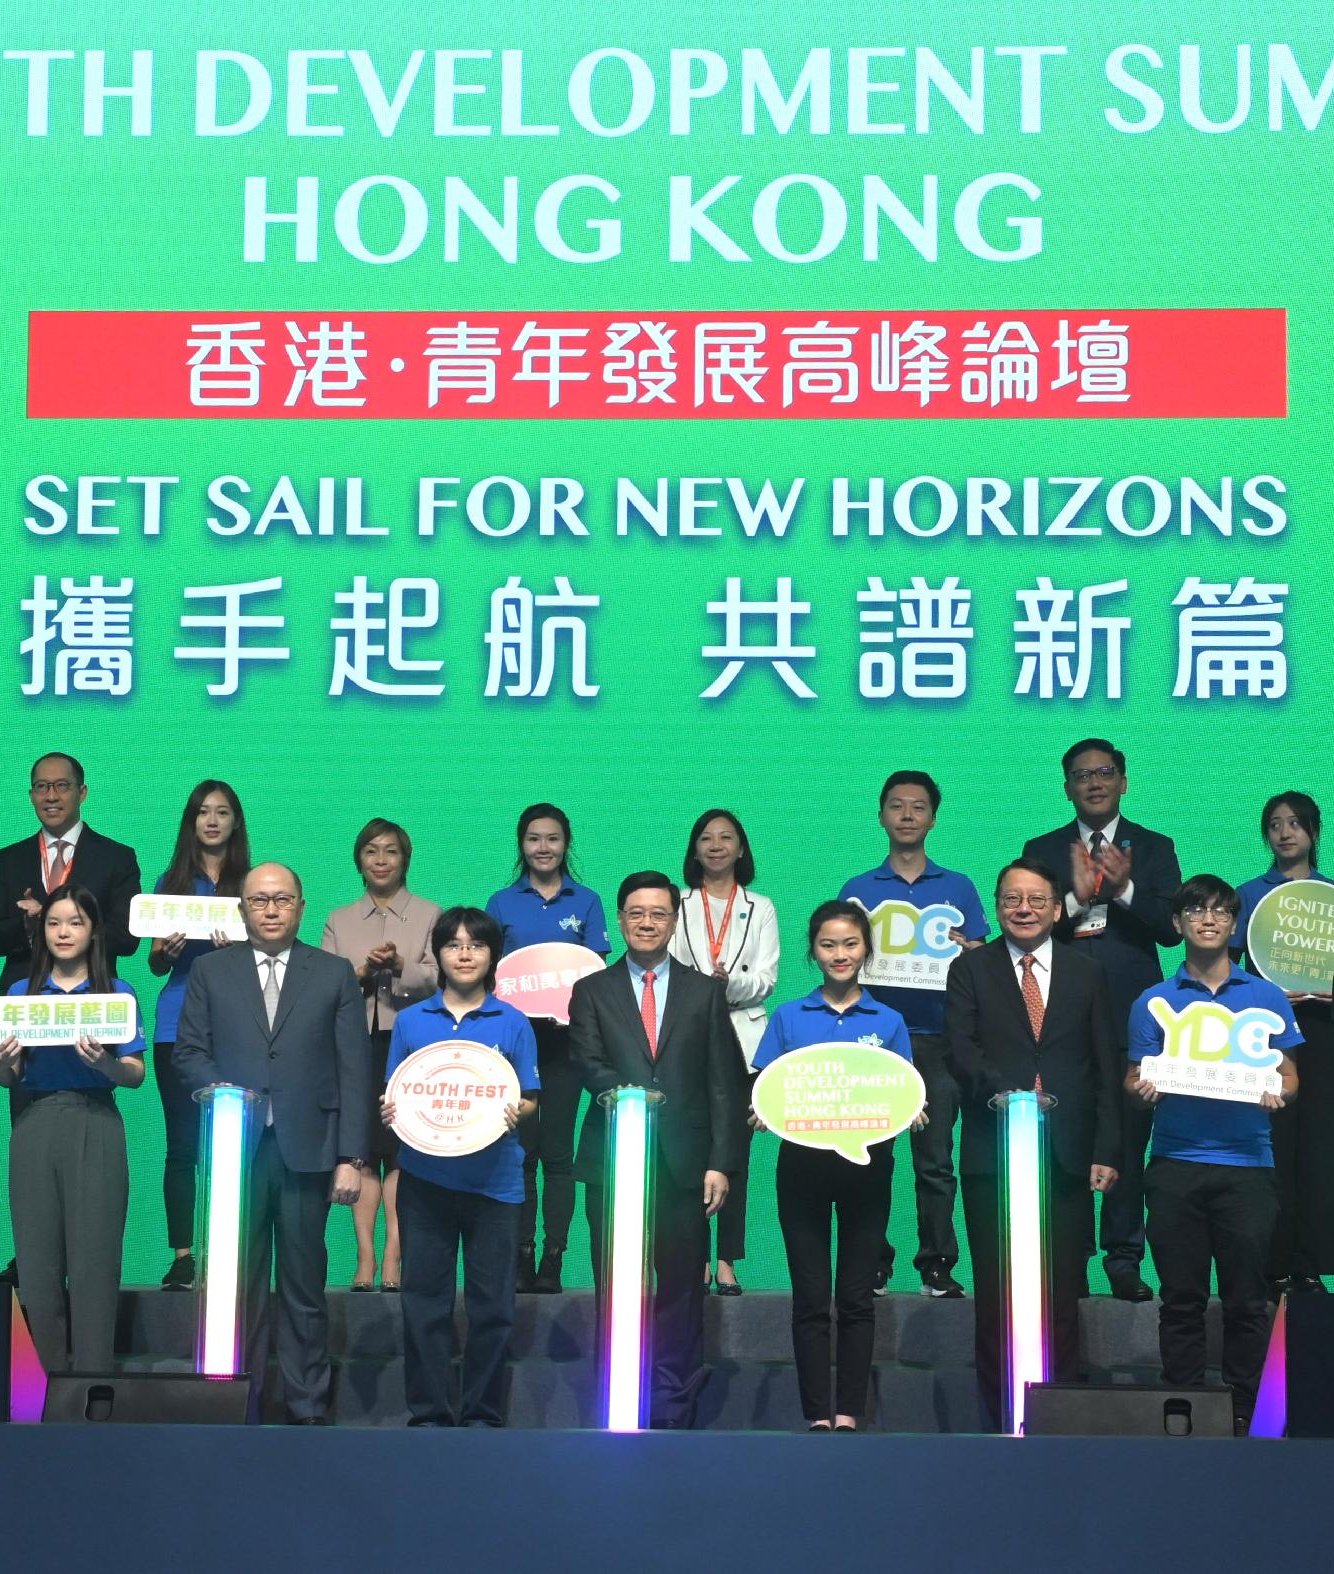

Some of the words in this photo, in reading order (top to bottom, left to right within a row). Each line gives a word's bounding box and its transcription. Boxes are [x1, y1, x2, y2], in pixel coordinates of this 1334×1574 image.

[194, 45, 1068, 138] DEVELOPMENT
[243, 174, 623, 265] HONG
[668, 172, 1044, 264] KONG
[184, 318, 1132, 409] 香港·青年發展高峰論壇
[23, 475, 180, 537] SET
[206, 475, 390, 537] SAIL
[418, 475, 591, 537] FOR
[616, 475, 805, 537] NEW
[832, 475, 1288, 537] HORIZONS
[19, 574, 601, 698] 攜手起航
[697, 575, 1290, 700] 共譜新篇
[870, 903, 963, 960] DC
[912, 976, 947, 986] Commiss
[11, 1028, 76, 1040] DEVELOPMENT
[79, 1026, 128, 1038] BLUEPRINT
[1152, 999, 1283, 1068] YDC
[785, 1060, 844, 1075] YOUTH
[402, 1082, 459, 1097] YOUTH
[464, 1084, 508, 1098] FEST
[783, 1073, 907, 1090] DEVELOPMENT
[431, 1098, 471, 1111] 青年節
[784, 1088, 852, 1105] SUMMIT
[784, 1104, 836, 1118] HONG
[841, 1103, 891, 1117] KONG
